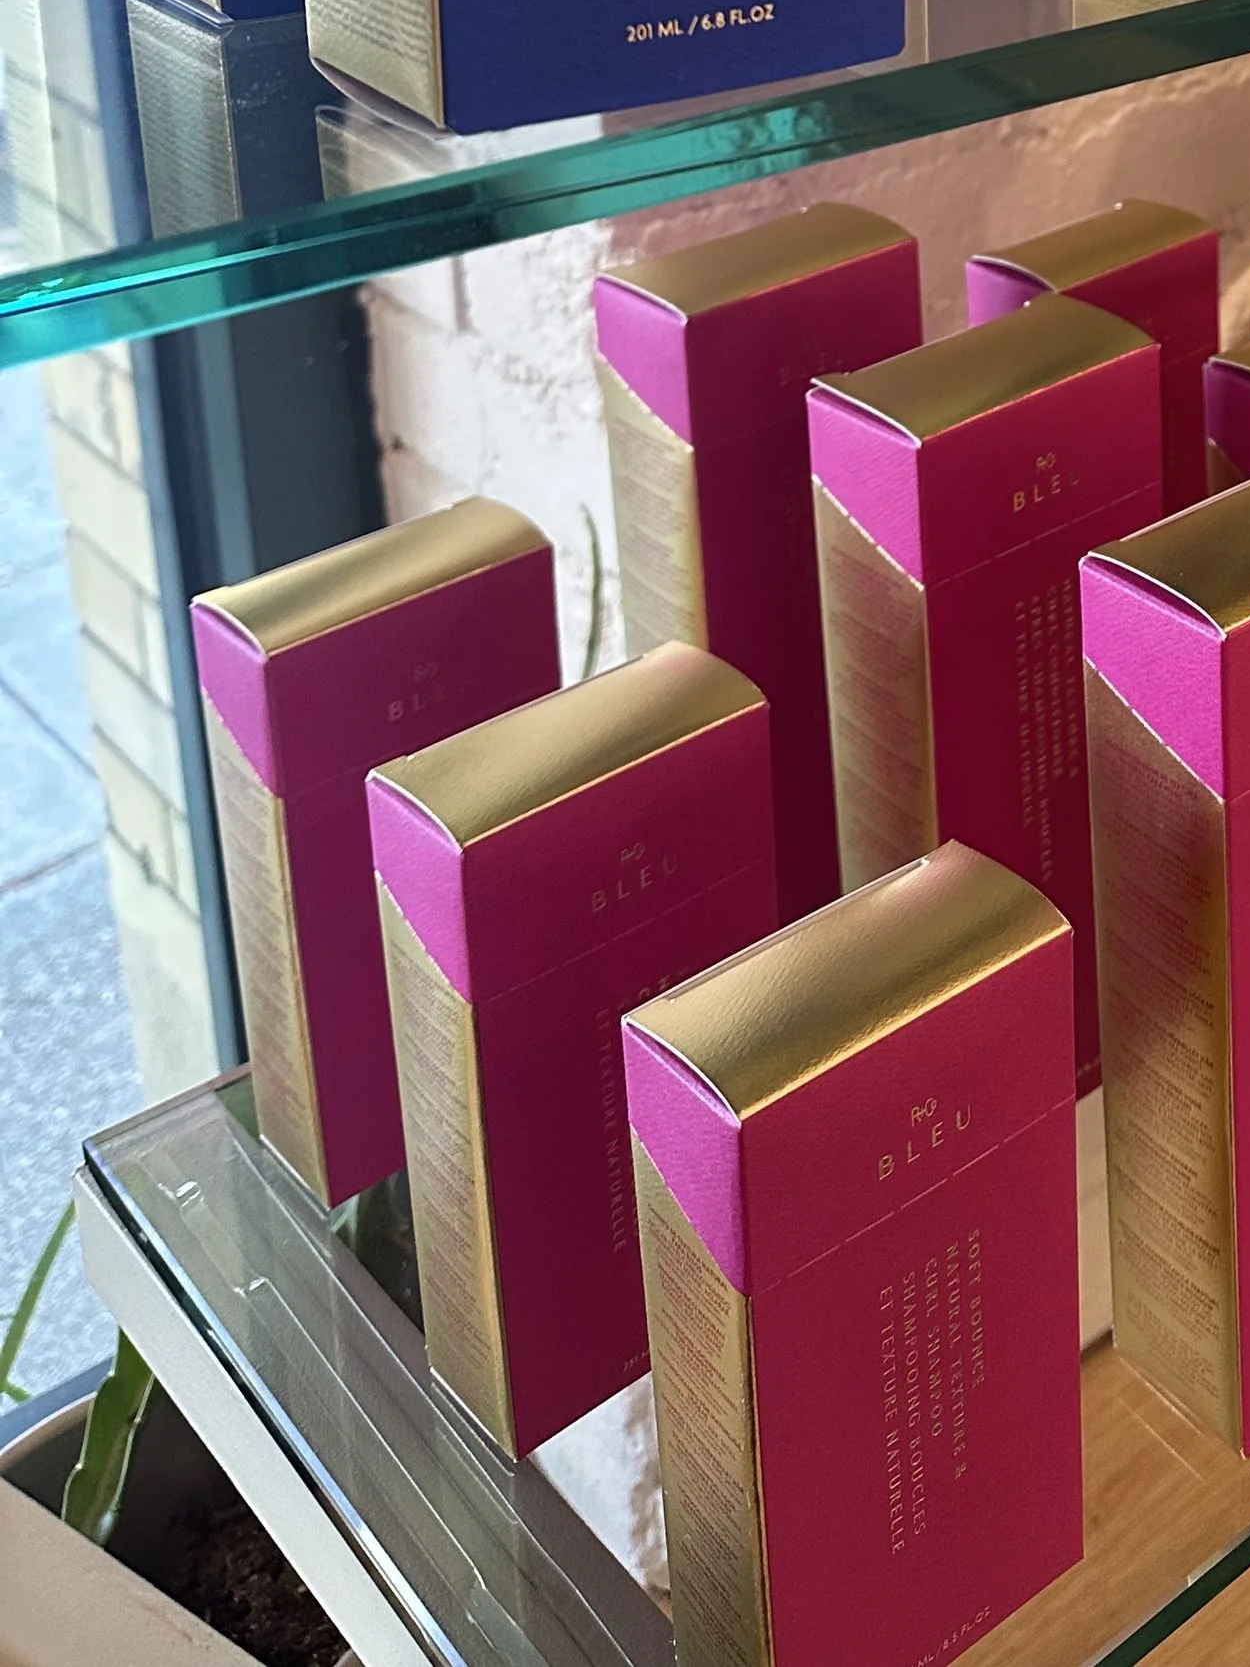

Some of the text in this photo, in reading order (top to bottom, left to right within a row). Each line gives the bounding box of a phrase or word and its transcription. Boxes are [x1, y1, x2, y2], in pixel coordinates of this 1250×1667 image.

[626, 22, 653, 42] 201
[657, 18, 684, 38] ML
[878, 1104, 971, 1181] BLEU
[924, 1254, 944, 1439] CURL SHAMPOO
[945, 1240, 963, 1350] NATURAL
[967, 1225, 986, 1389] SOFT BOUNCE
[879, 1283, 907, 1555] ET TEXTURE NATURELLE
[901, 1268, 927, 1537] SHAMPOOING BOUCLES
[949, 1352, 967, 1458] TEXTURE
